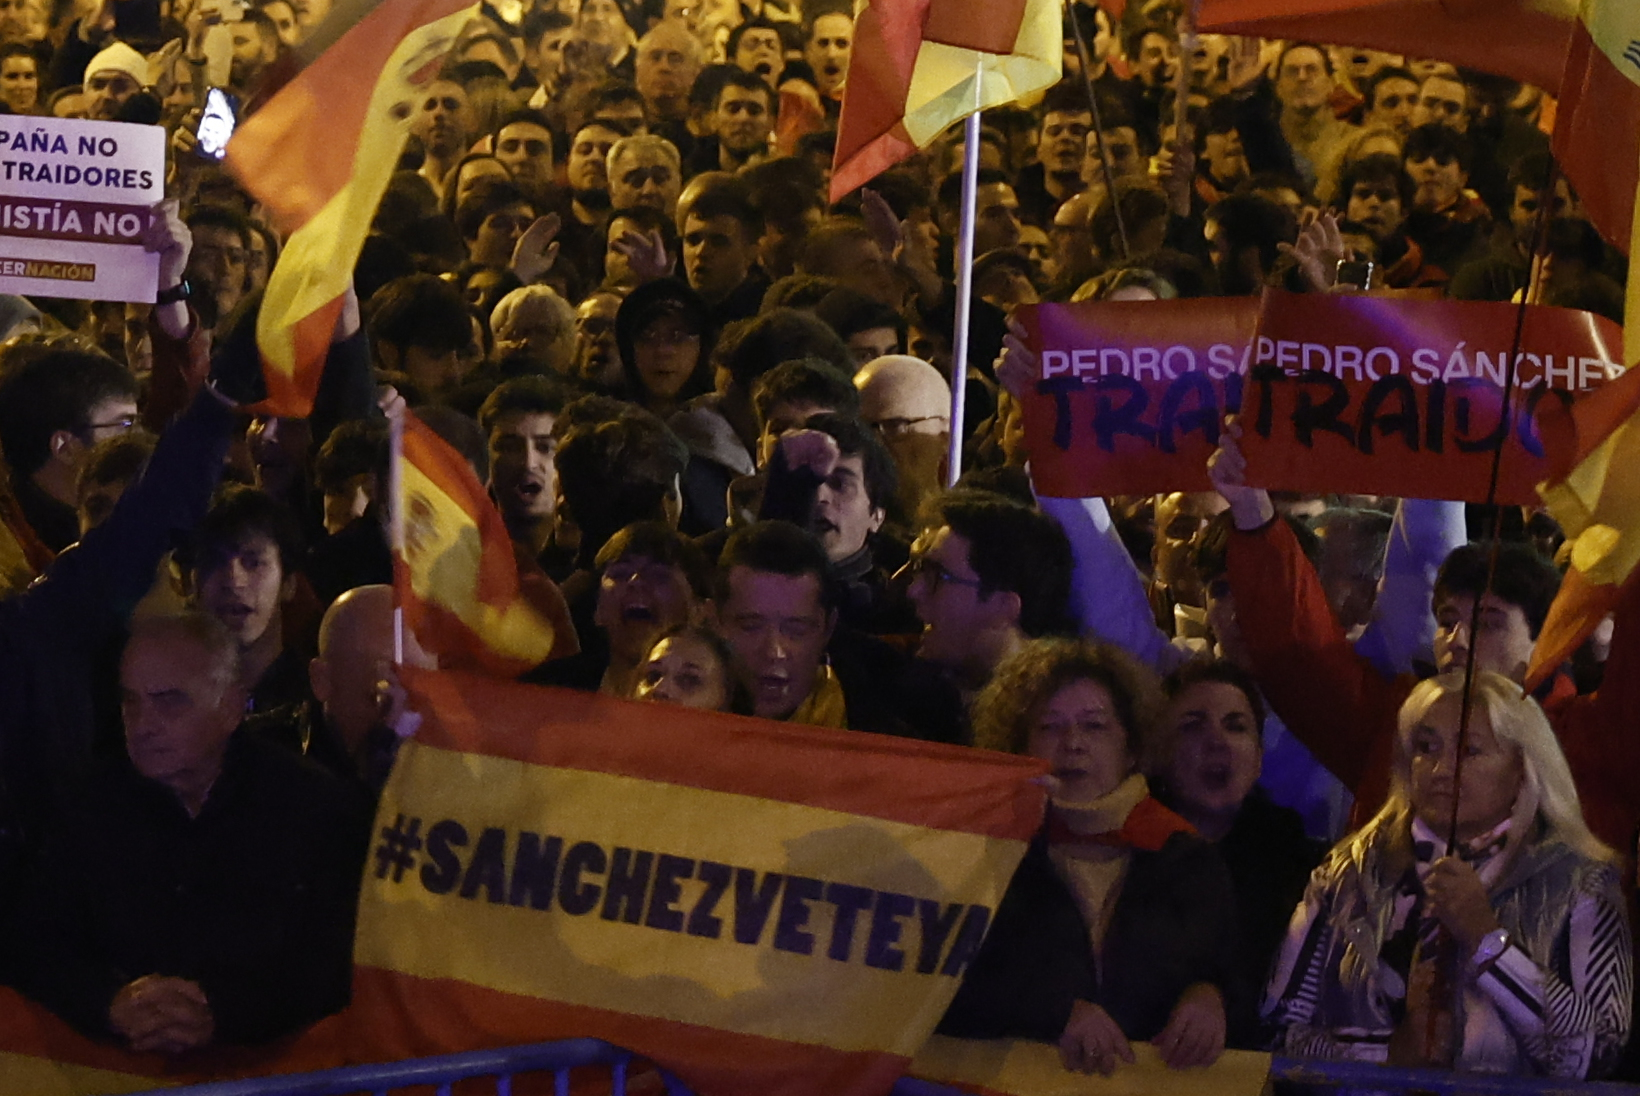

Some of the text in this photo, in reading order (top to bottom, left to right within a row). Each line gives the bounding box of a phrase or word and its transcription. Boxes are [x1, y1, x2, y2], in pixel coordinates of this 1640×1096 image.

[79, 135, 118, 157] NO
[2, 160, 153, 189] TRAIDORES
[93, 212, 140, 236] NO
[1042, 344, 1196, 383] PEDRO
[1256, 336, 1399, 381] PEDRO
